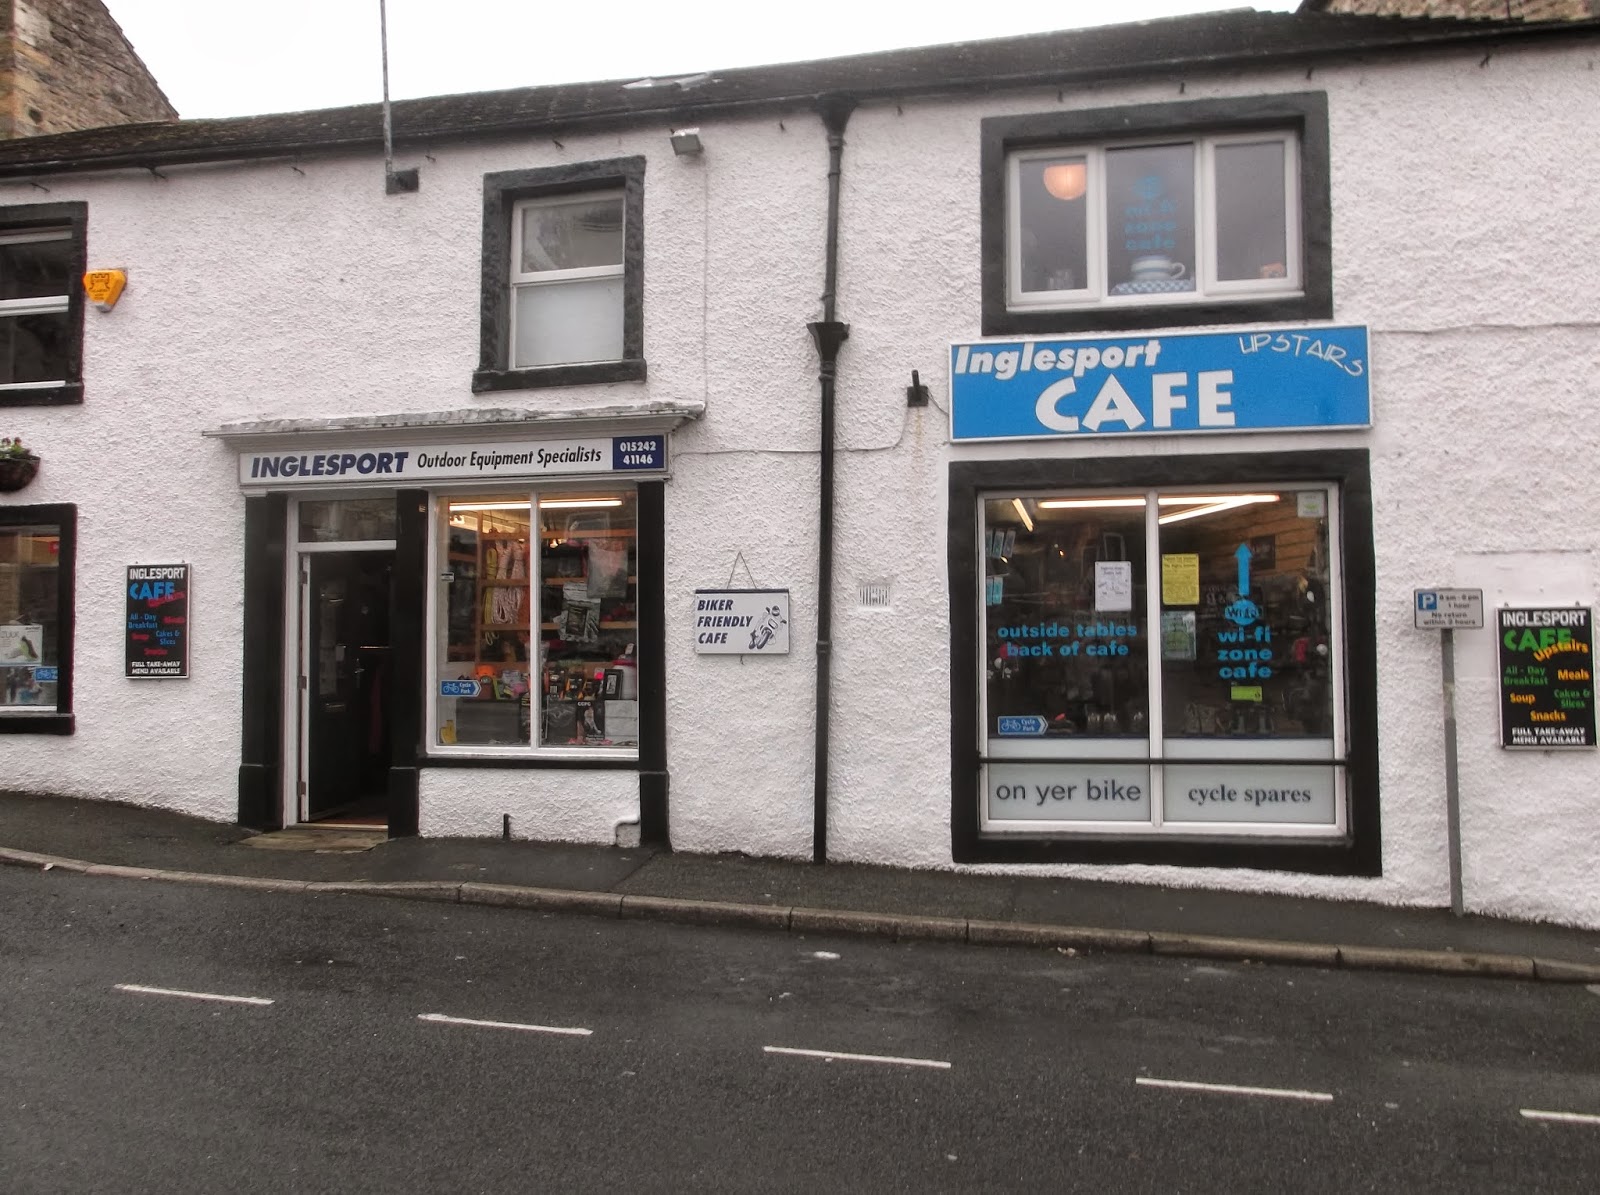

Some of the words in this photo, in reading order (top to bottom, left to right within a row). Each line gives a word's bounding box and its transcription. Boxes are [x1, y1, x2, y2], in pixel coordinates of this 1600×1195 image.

[954, 339, 1161, 380] Inglesport
[1238, 333, 1364, 377] UPSTAIRS
[1034, 369, 1236, 432] CAFE
[620, 441, 657, 452] 015242
[251, 452, 409, 478] INGLESPORT
[417, 451, 467, 469] Outdoor
[470, 450, 534, 470] Equipment
[537, 446, 602, 468] Specialists
[623, 453, 654, 465] 41146
[129, 567, 186, 580] INGLESPORT
[129, 581, 175, 600] CAFE
[697, 599, 734, 611] BIKER
[1422, 594, 1435, 609] P
[697, 615, 753, 627] FRIENDLY
[1502, 610, 1586, 627] INGLESPORT
[698, 632, 728, 644] CAFE
[998, 622, 1070, 638] outside
[1076, 622, 1137, 638] tables
[1218, 625, 1272, 643] wi-fi
[1006, 641, 1053, 656] back
[1059, 640, 1080, 656] of
[1085, 640, 1129, 656] cafe
[1503, 628, 1572, 652] CAFE
[1218, 649, 1272, 661] zone
[1533, 639, 1589, 662] Upstairs
[1219, 662, 1272, 678] cafe
[1557, 669, 1590, 681] Meals
[1510, 692, 1536, 705] Soup
[1530, 710, 1567, 722] Snacks
[996, 783, 1027, 800] on
[1035, 783, 1078, 806] yer
[1086, 780, 1142, 801] bike
[1188, 783, 1238, 806] cycle
[1244, 786, 1312, 806] spares
